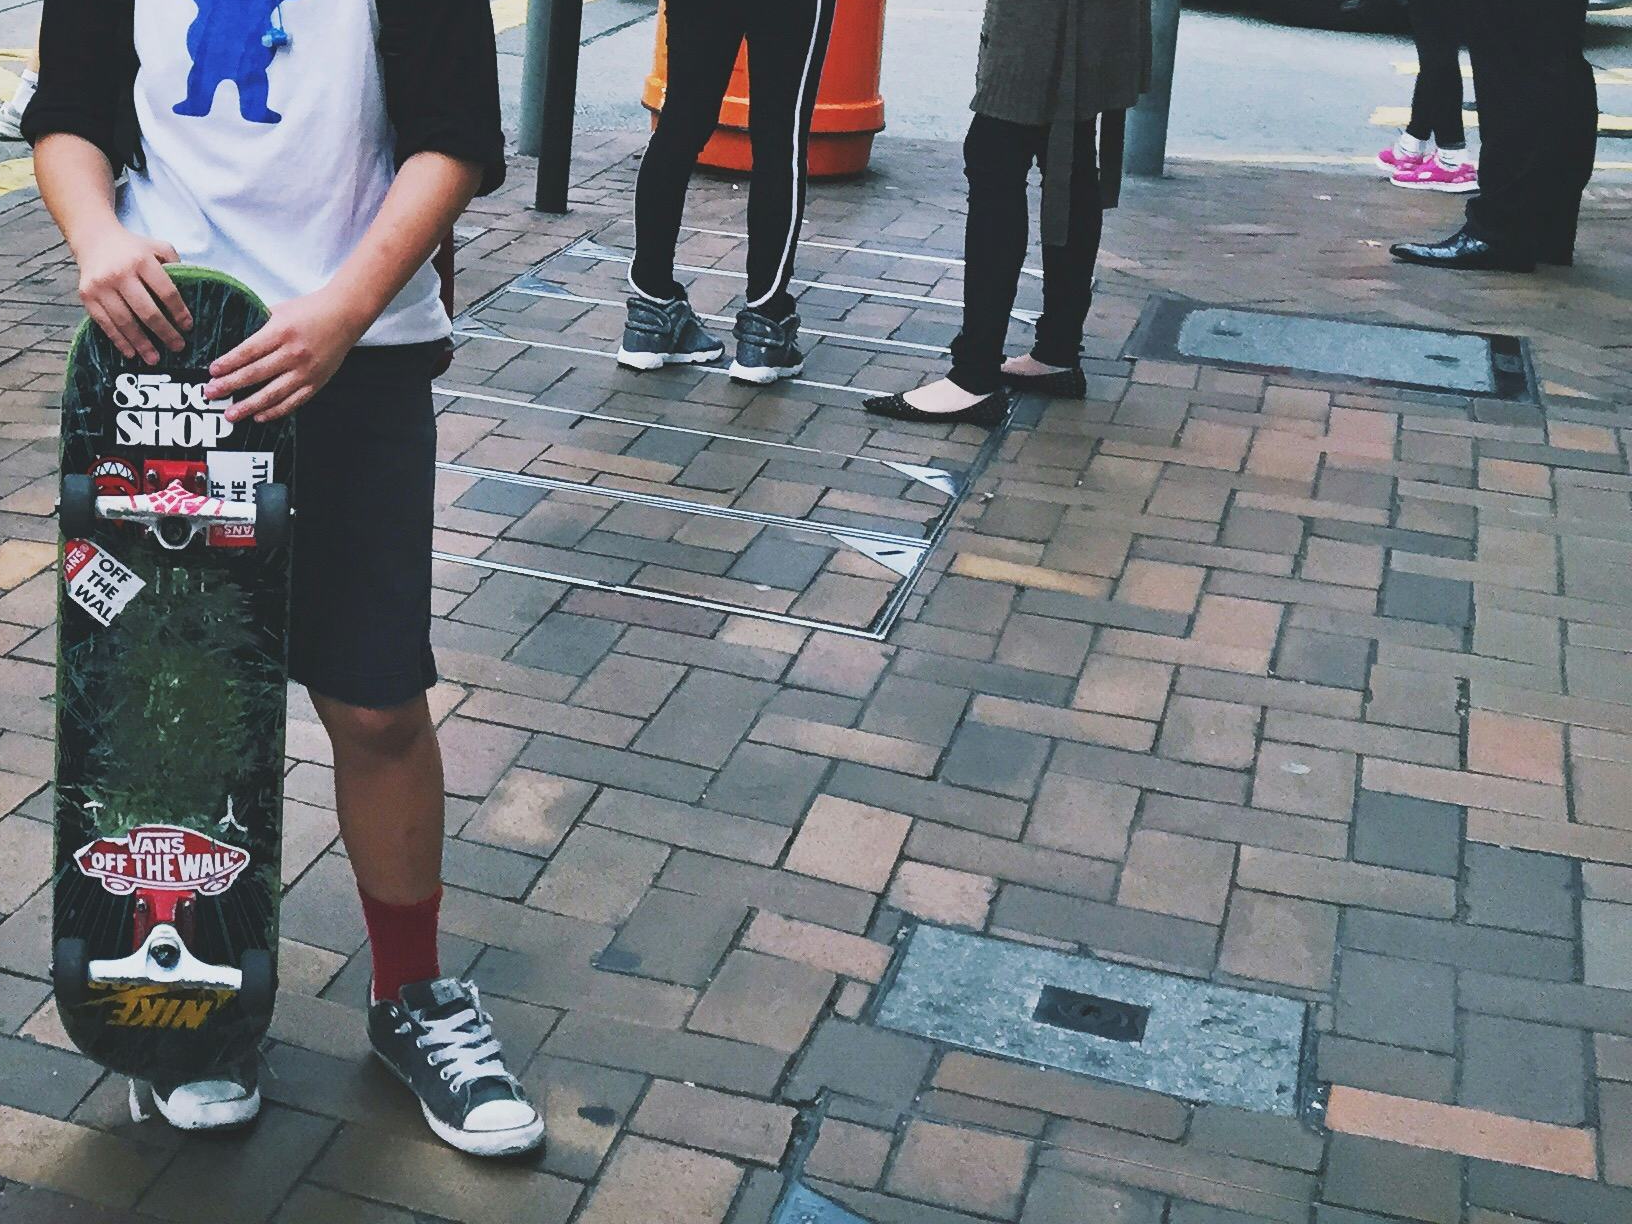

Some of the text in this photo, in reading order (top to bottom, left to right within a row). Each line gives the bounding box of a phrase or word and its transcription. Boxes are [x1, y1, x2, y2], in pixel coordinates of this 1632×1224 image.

[116, 410, 234, 447] SHOP
[87, 569, 120, 600] THE
[127, 832, 186, 854] VANS
[131, 853, 176, 881] THE
[106, 997, 214, 1030] NIKE
